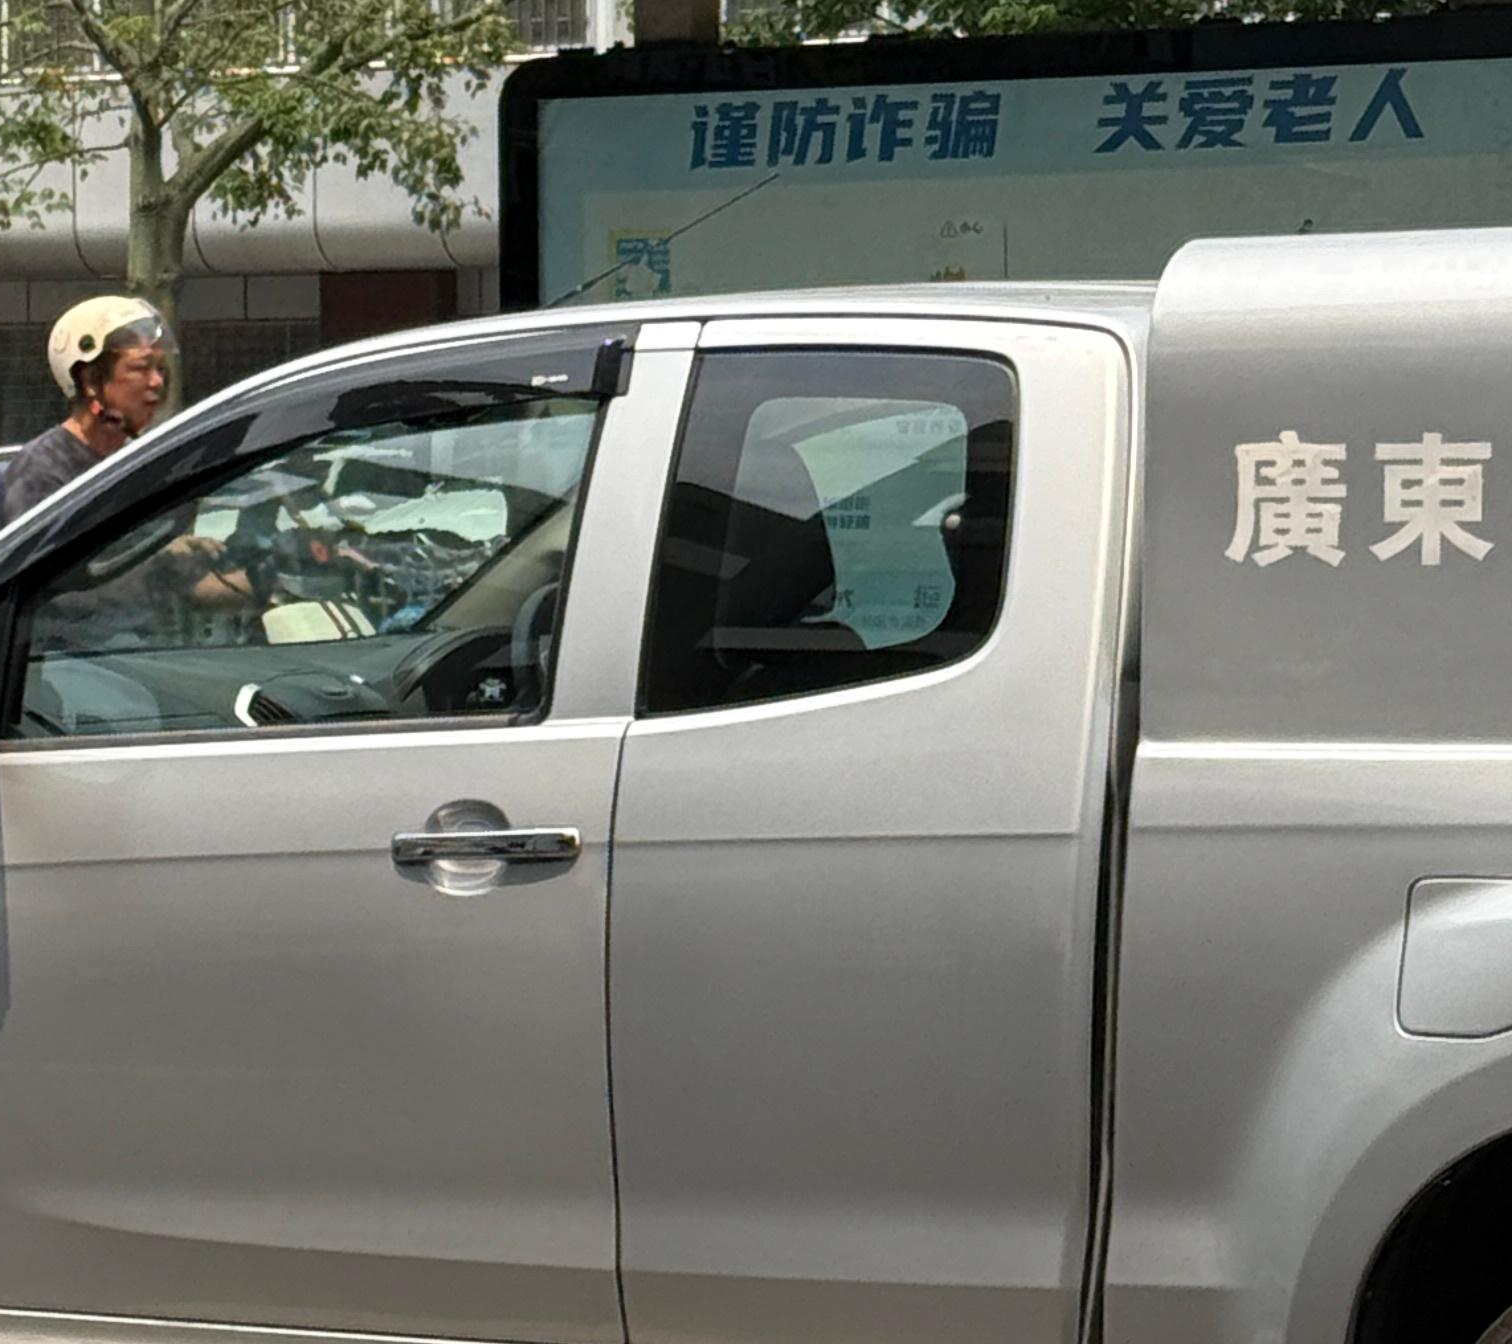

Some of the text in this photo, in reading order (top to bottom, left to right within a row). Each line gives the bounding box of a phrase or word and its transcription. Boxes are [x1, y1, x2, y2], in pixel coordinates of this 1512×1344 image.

[689, 67, 1426, 172] 谨防诈骗 关爱老人
[1224, 430, 1495, 567] 廣東
